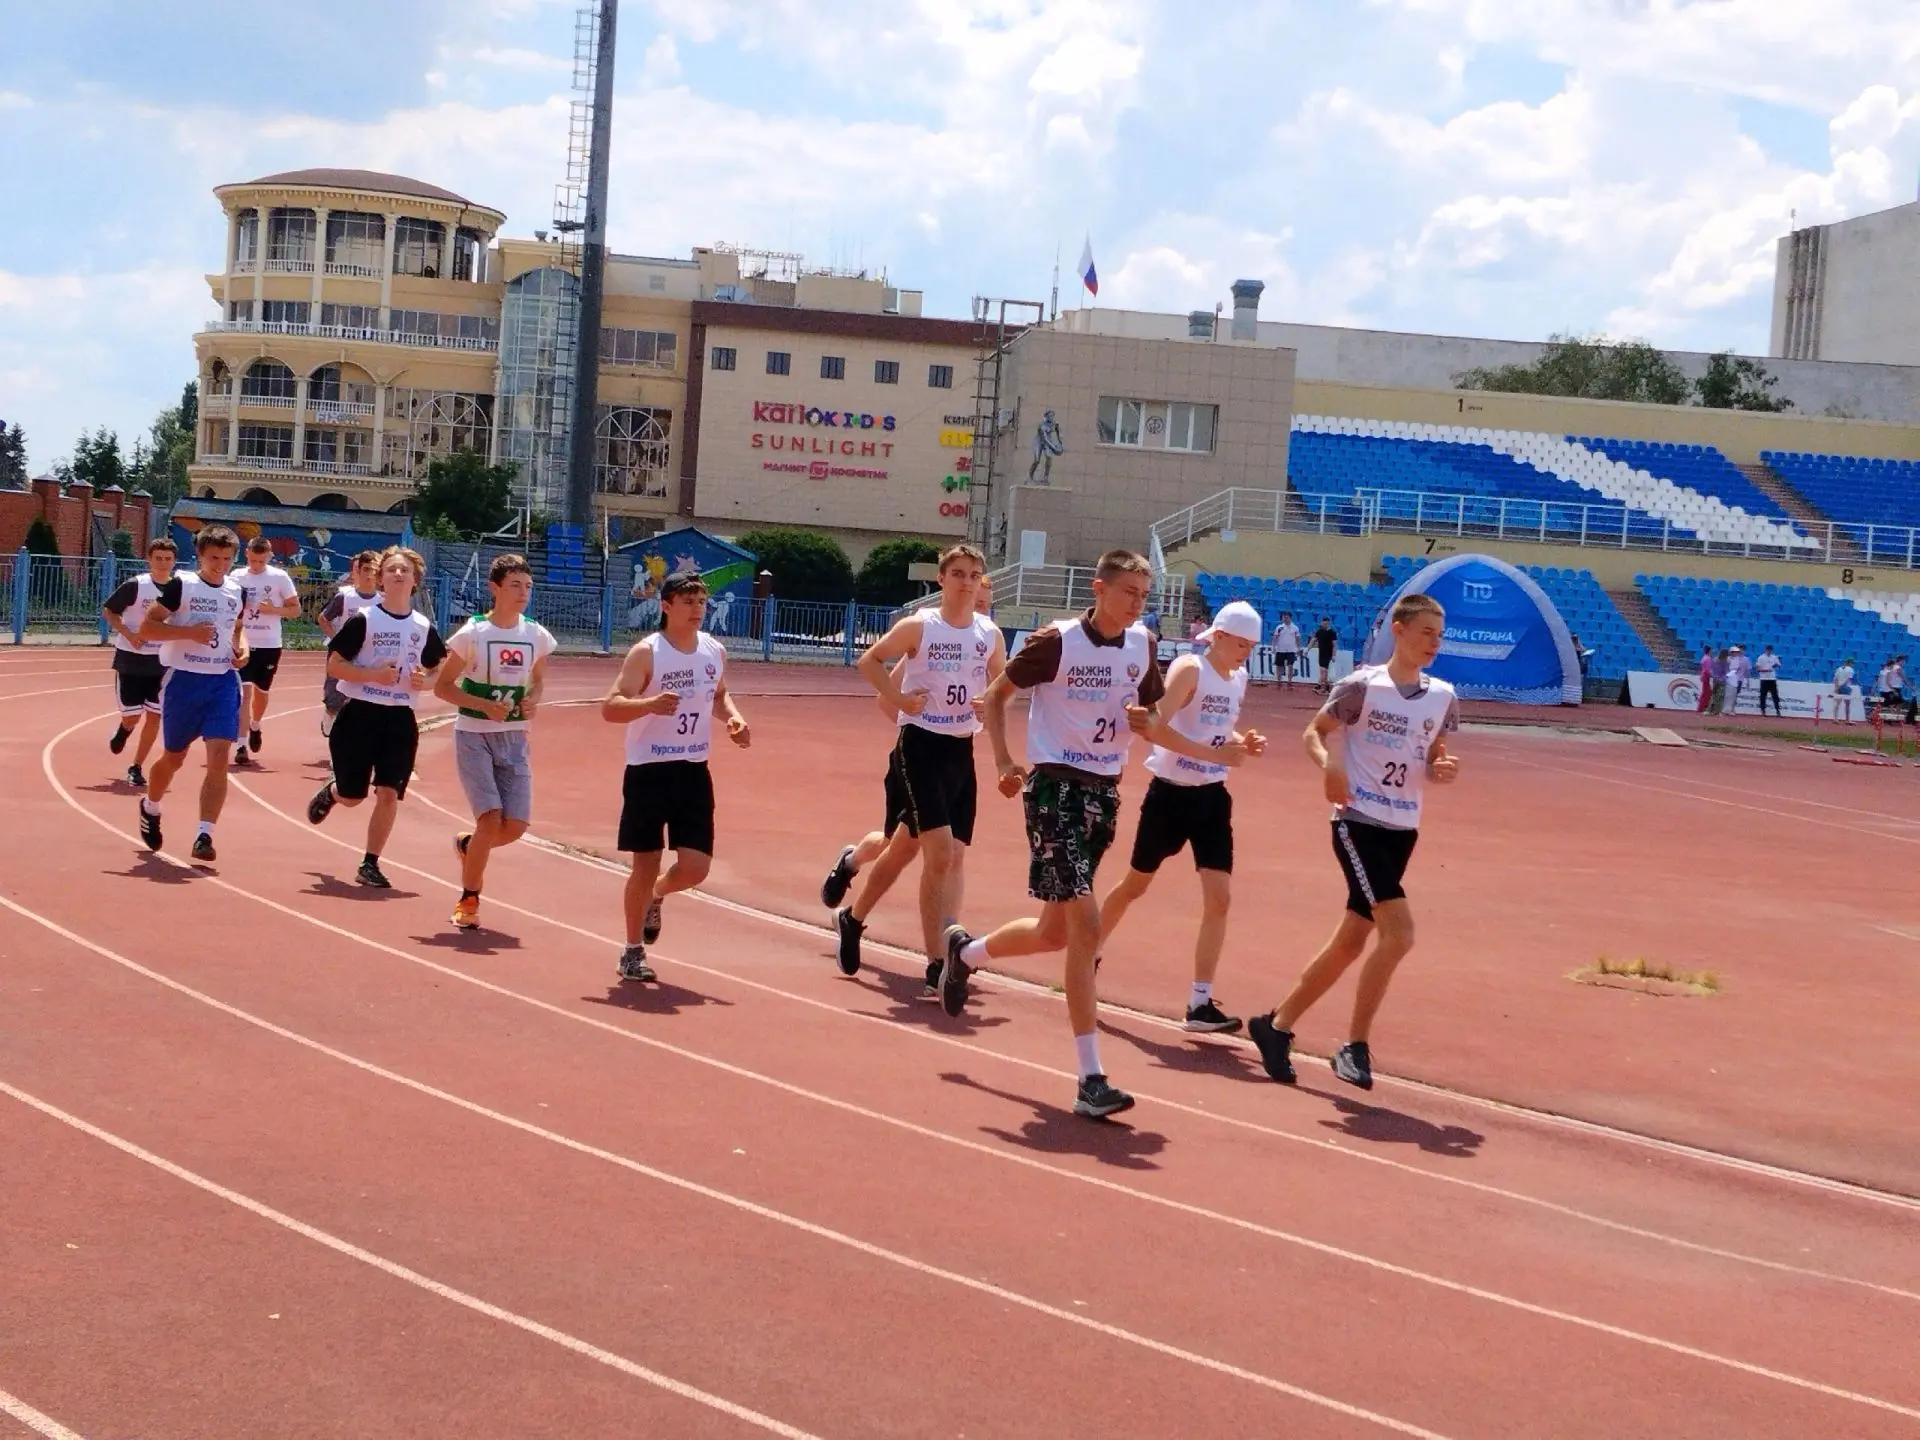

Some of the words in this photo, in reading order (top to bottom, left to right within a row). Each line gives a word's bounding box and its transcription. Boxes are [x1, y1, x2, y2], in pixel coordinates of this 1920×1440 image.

[753, 401, 805, 424] kari
[751, 433, 894, 457] SUNLIGHT
[1425, 539, 1436, 554] 7
[1842, 569, 1853, 584] 8
[1443, 627, 1468, 640] ДНА
[928, 643, 962, 651] ЛЫЖНЯ
[928, 652, 962, 661] РОССИИ
[1067, 666, 1112, 677] ЛЫЖНЯ
[1067, 677, 1112, 688] РОССИИ
[946, 685, 967, 705] 50
[677, 713, 700, 735] 37
[1092, 717, 1117, 743] 21
[1367, 720, 1408, 736] РОССИИ
[1382, 761, 1407, 788] 23
